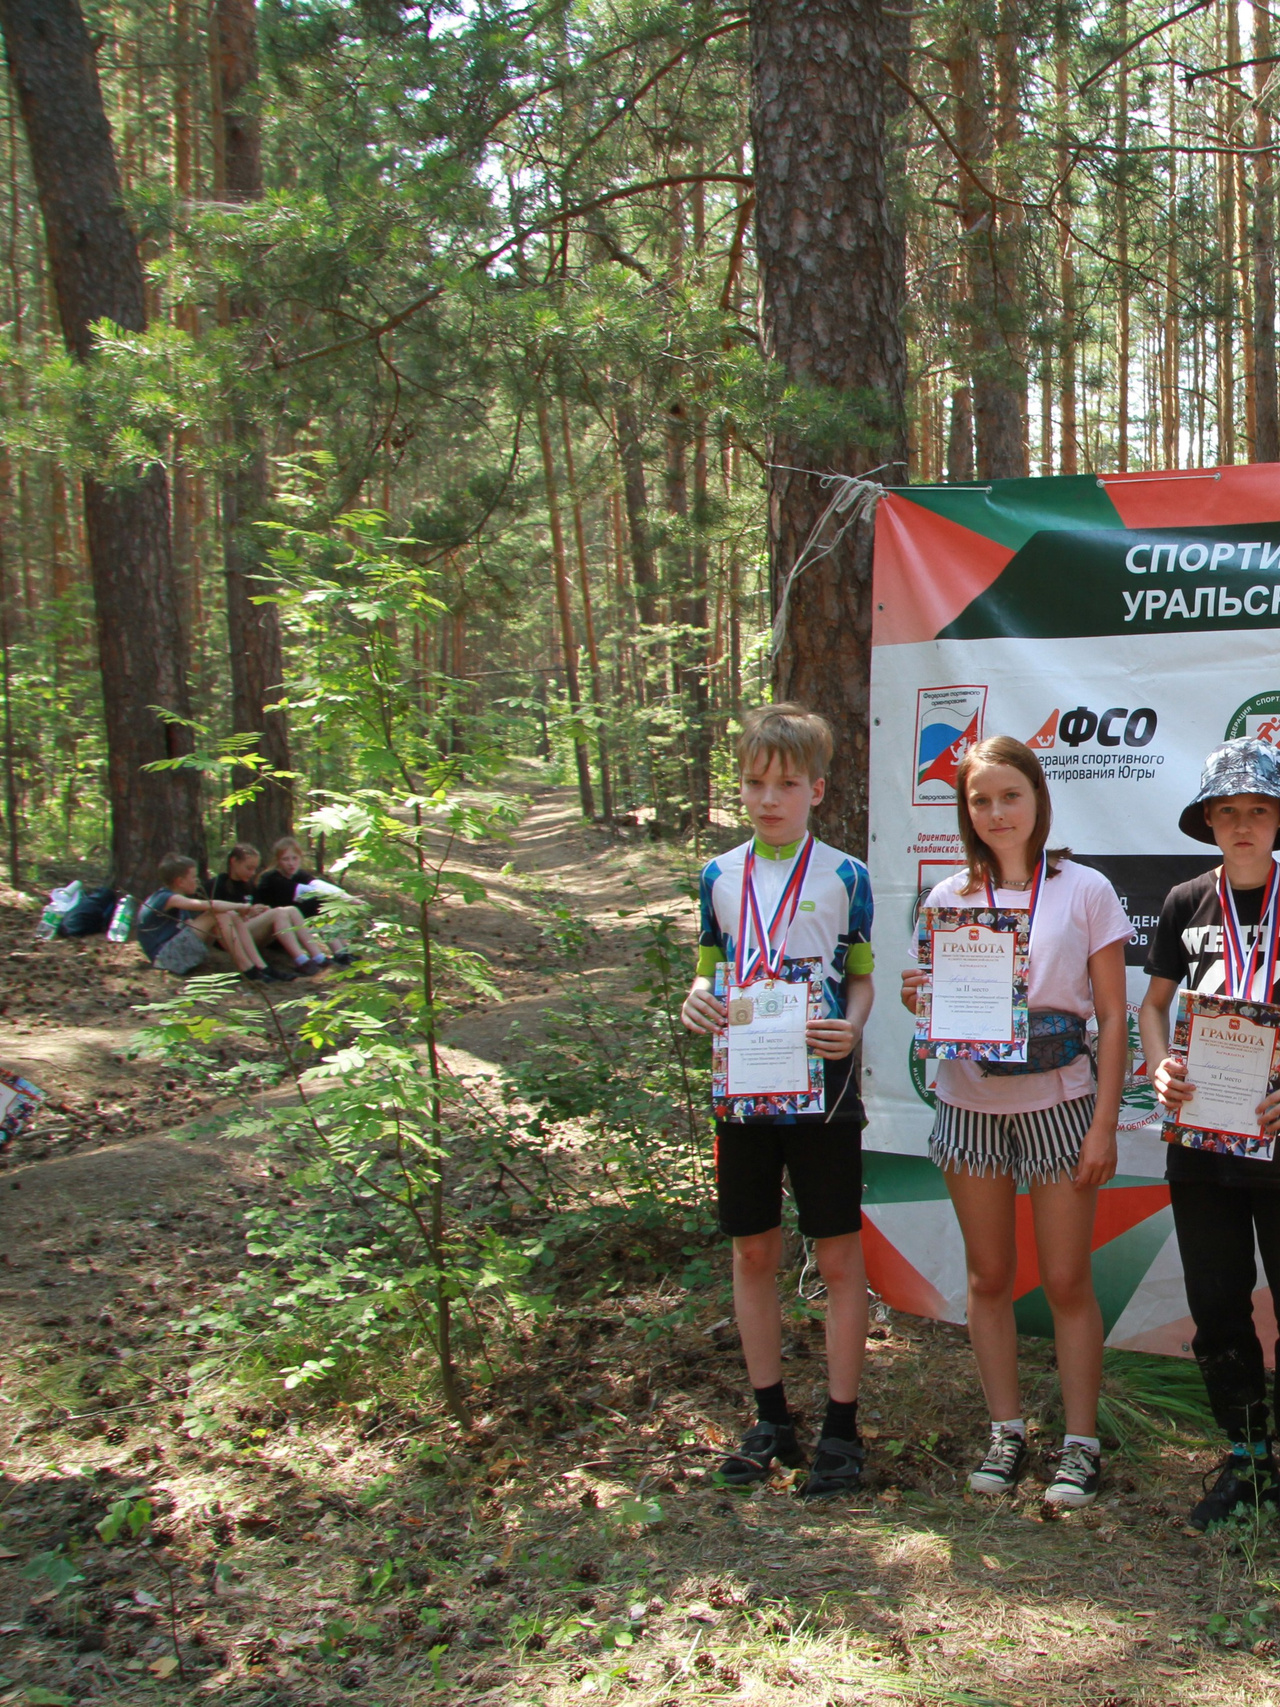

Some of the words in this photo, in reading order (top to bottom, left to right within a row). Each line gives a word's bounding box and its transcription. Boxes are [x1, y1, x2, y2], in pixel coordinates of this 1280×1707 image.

[1058, 706, 1158, 748] ФСО
[1229, 705, 1253, 740] ЕДЕРАЦИЯ
[1039, 754, 1079, 767] ерация
[1081, 753, 1165, 768] спортивного
[1044, 768, 1115, 783] нтирования
[1118, 766, 1156, 782] Югры
[917, 832, 961, 844] Ориентиро
[912, 843, 959, 854] Челябинской
[942, 942, 1005, 954] ГРАМОТА
[1200, 1026, 1266, 1047] ГРАМОТА
[1126, 1111, 1160, 1131] ОБЛАСТИ
